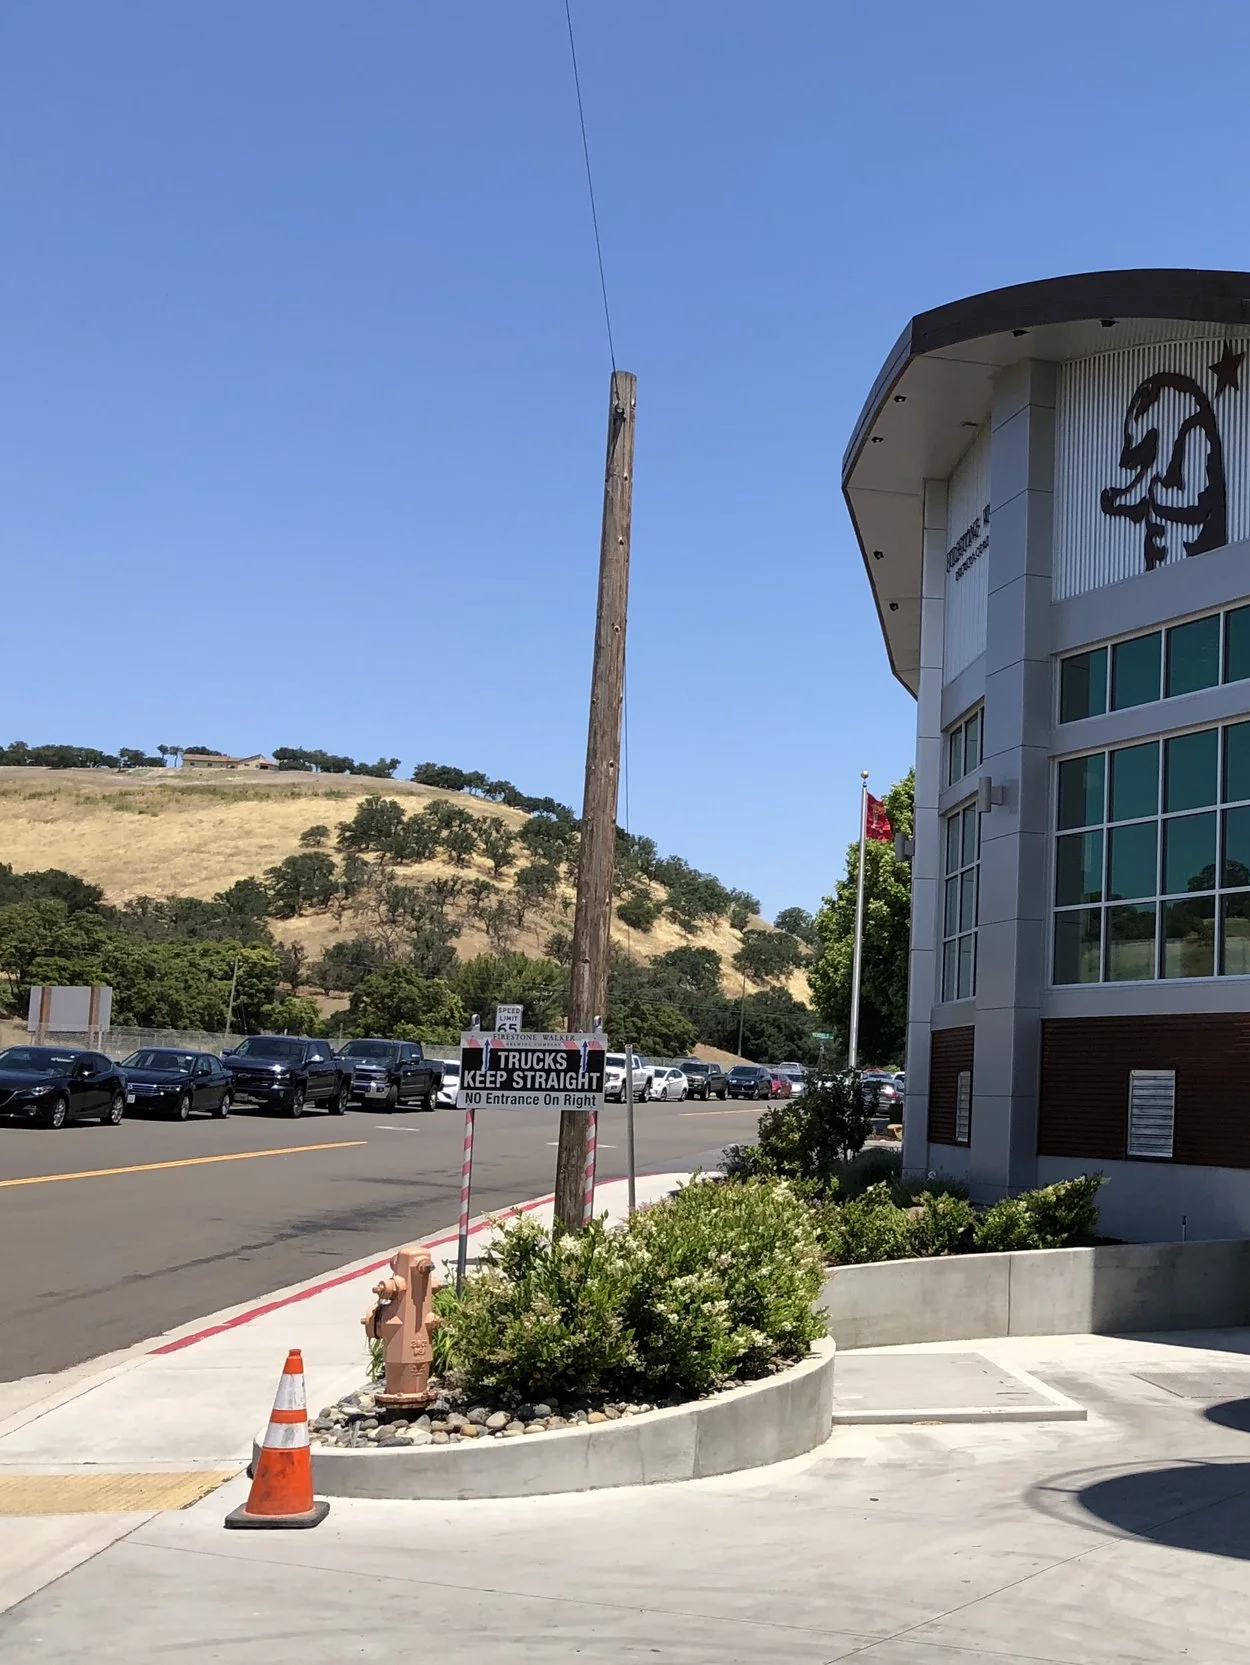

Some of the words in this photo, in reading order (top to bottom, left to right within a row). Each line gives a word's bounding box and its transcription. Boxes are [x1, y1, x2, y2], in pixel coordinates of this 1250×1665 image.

[493, 1033, 537, 1041] FIRESTONE
[498, 1051, 567, 1070] TRUCKS
[464, 1070, 507, 1088] KEEP
[512, 1071, 600, 1090] STRAIGHT
[465, 1092, 482, 1104] NO
[486, 1093, 539, 1105] Entrance
[544, 1093, 558, 1106] On
[563, 1094, 596, 1109] Right
